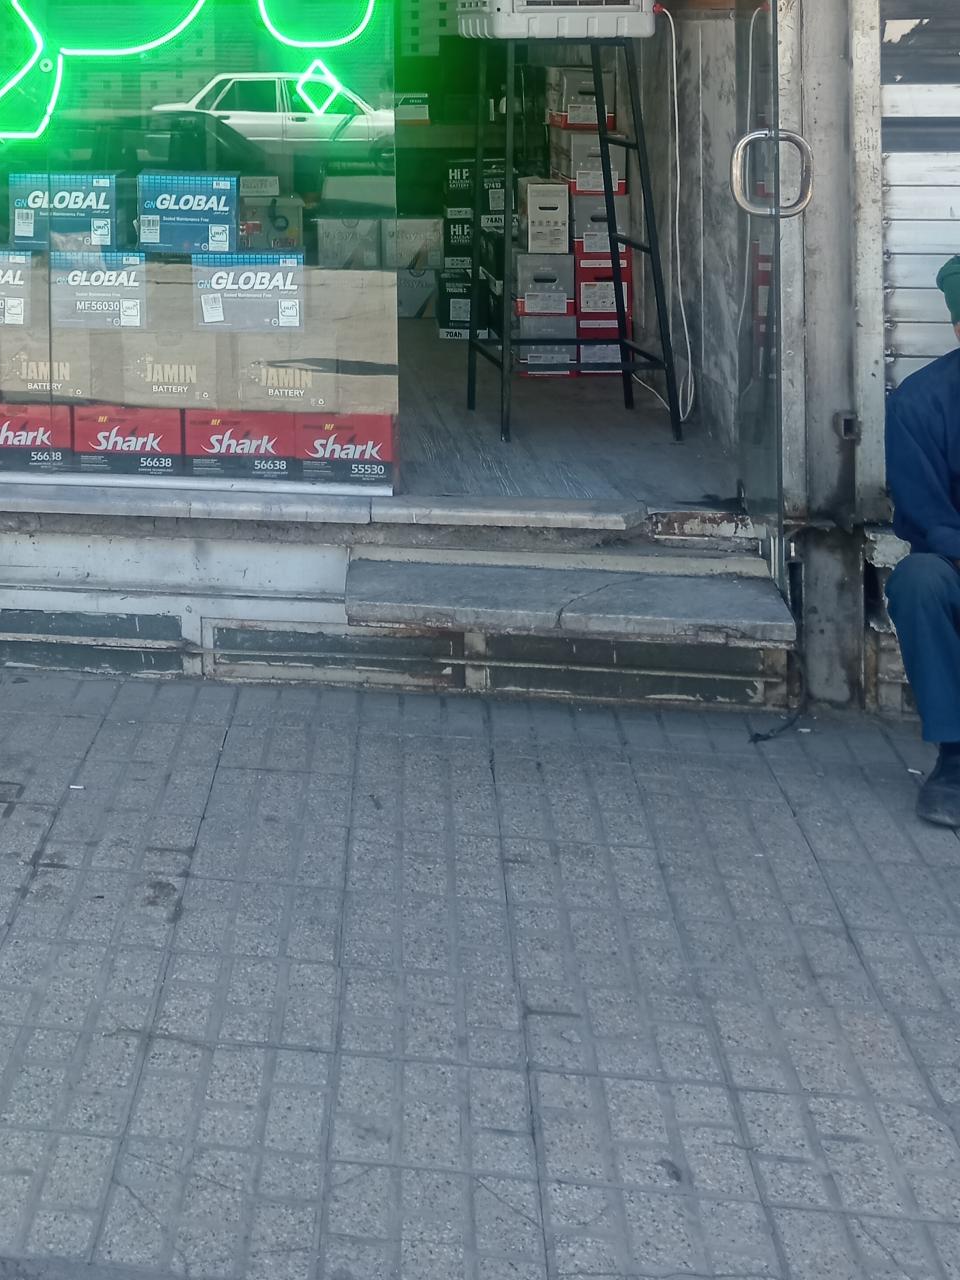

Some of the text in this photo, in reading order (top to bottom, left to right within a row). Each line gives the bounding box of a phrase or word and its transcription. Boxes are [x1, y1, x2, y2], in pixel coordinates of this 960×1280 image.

[27, 190, 111, 210] GLOBAL
[155, 193, 230, 211] GLOBAL
[67, 270, 140, 287] GLOBAL
[210, 271, 299, 290] GLOBAL
[27, 382, 63, 391] BATTERY
[152, 384, 189, 394] BATTERY
[268, 388, 305, 397] BATTERY
[88, 425, 165, 453] Shark
[200, 428, 279, 455] Shark
[304, 433, 384, 461] Shark
[139, 457, 172, 468] 56638
[253, 460, 287, 470] 56638
[350, 464, 385, 475] 55530
